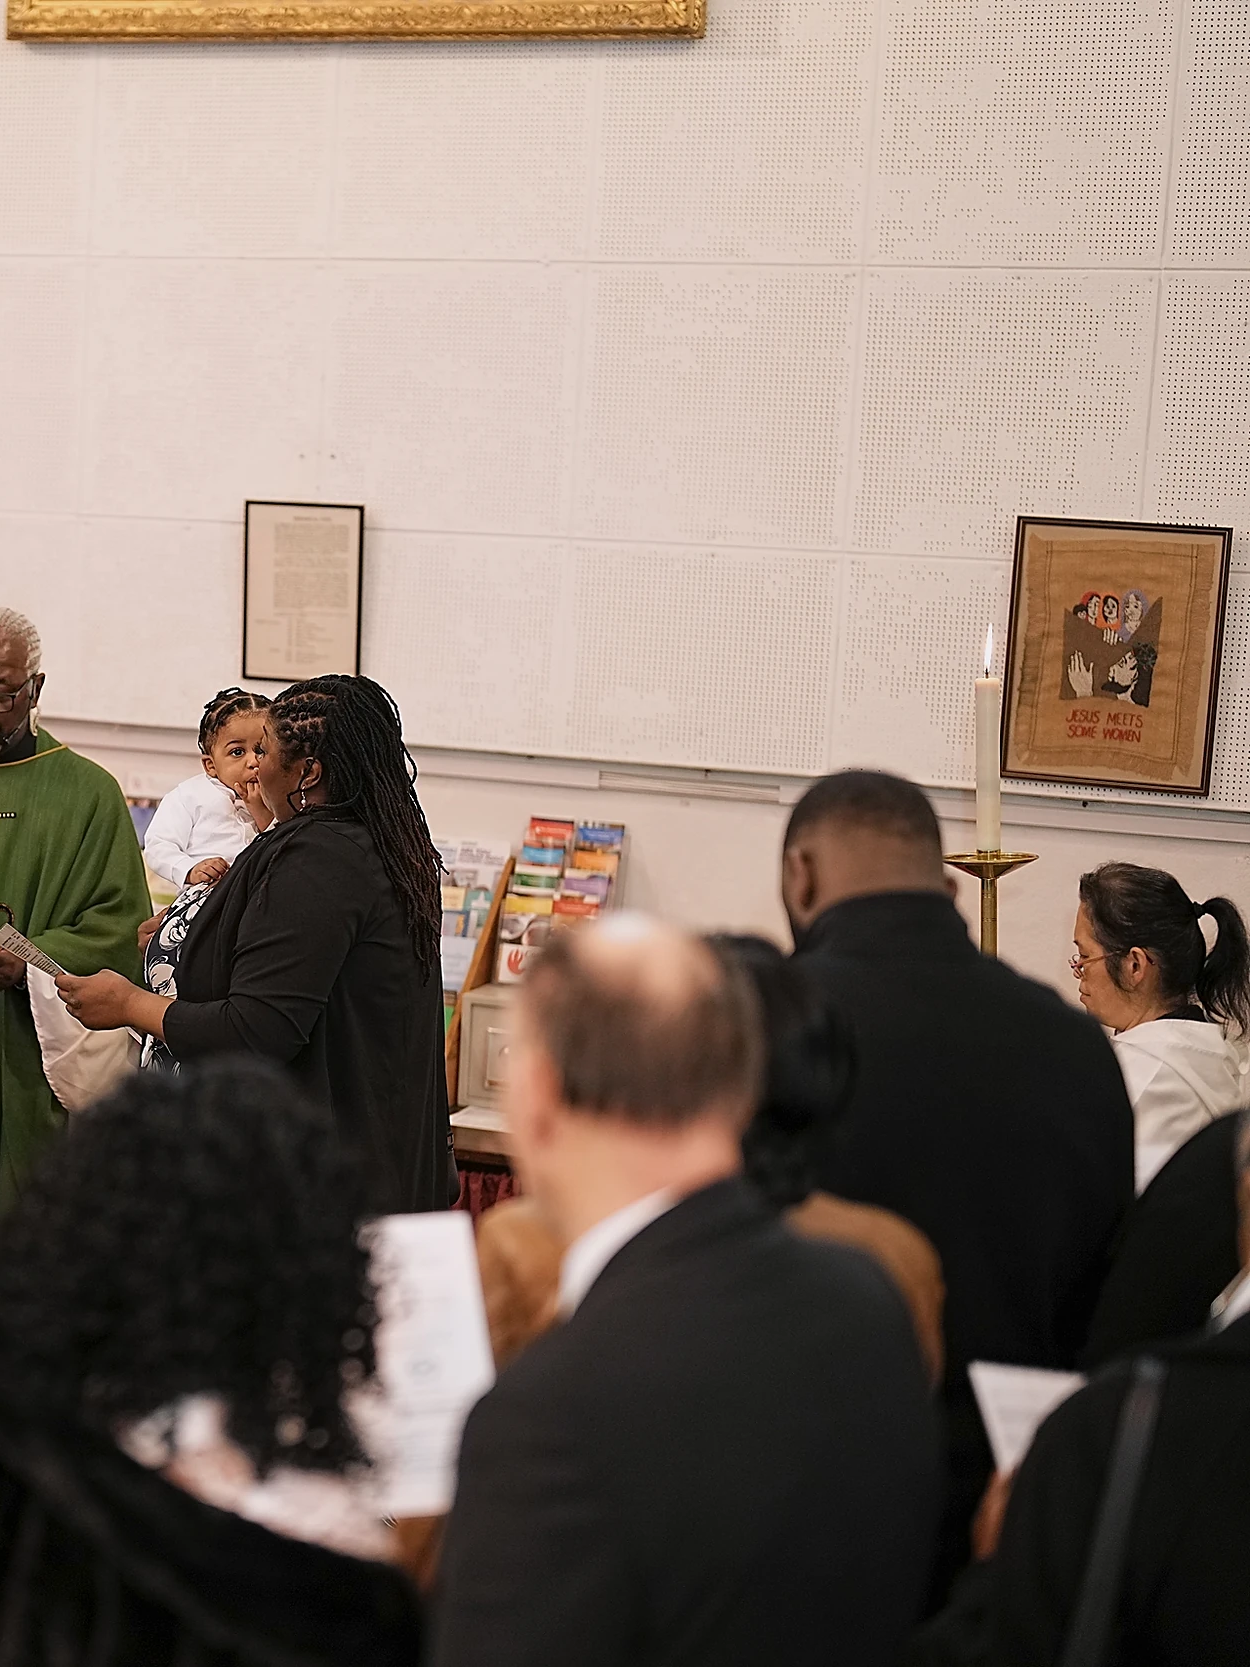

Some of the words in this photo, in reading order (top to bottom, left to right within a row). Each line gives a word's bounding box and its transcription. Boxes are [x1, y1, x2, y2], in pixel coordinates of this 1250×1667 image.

[1065, 709, 1101, 724] JESUS
[1106, 712, 1144, 728] MEETS
[1067, 724, 1097, 739] SOME
[1102, 727, 1141, 743] WOMEN
